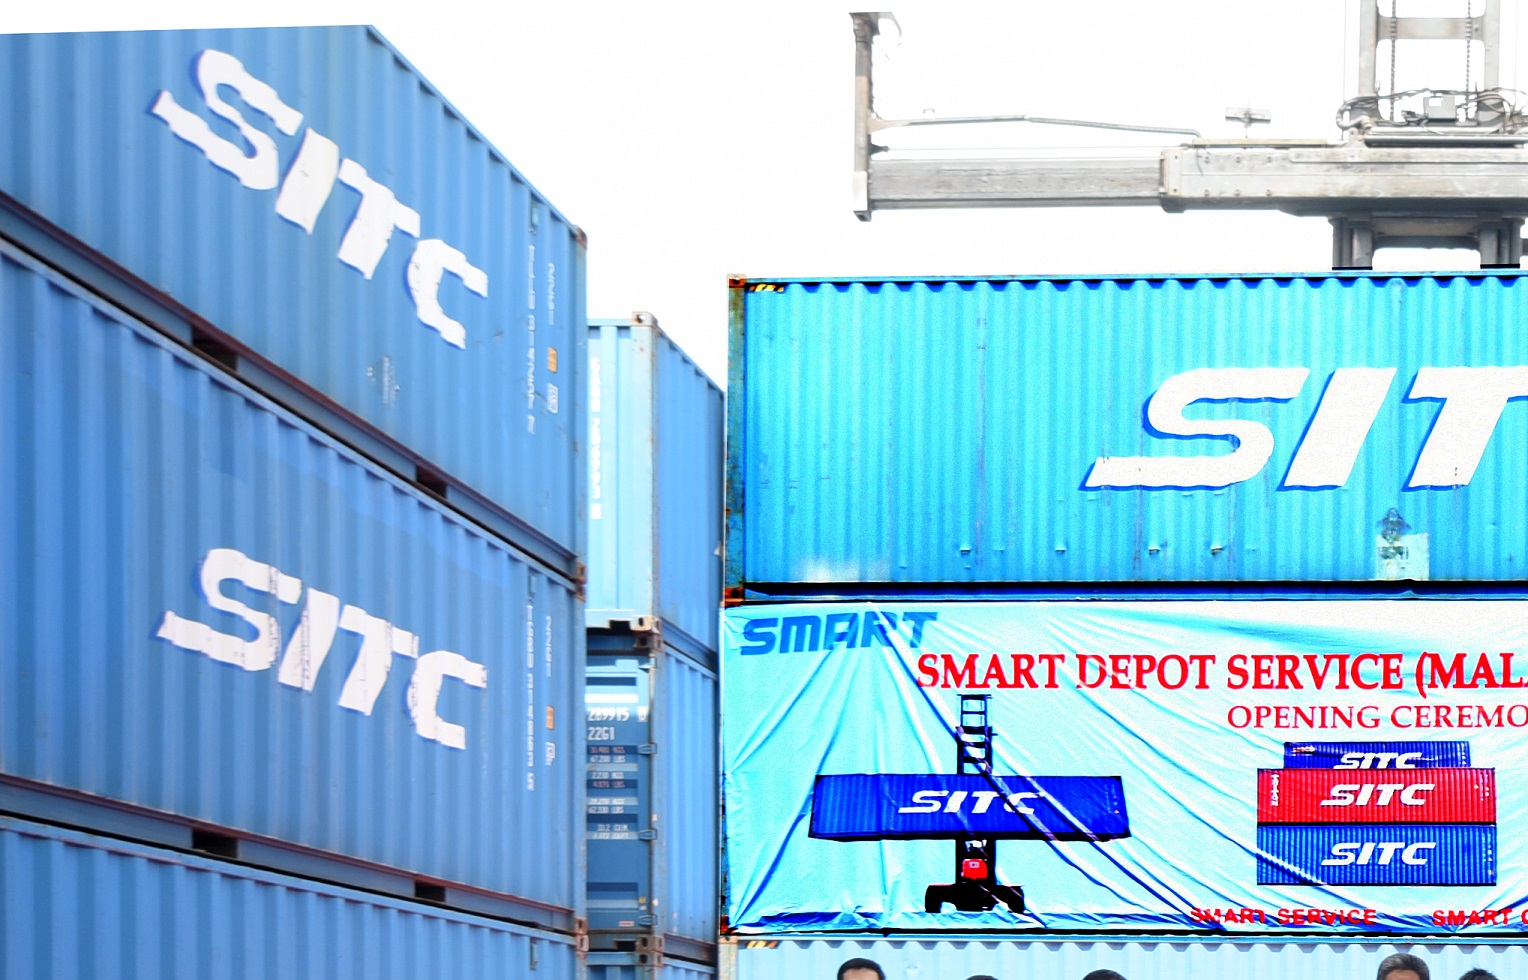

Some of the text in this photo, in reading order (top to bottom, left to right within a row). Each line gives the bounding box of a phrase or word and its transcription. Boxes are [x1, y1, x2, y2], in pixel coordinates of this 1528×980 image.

[150, 48, 488, 350] SITC
[740, 610, 938, 656] SMART
[155, 547, 488, 750] SITC
[916, 652, 1066, 690] SMART
[1076, 652, 1217, 691] DEPOT
[1227, 652, 1404, 690] SERVICE
[1227, 704, 1381, 730] OPENING
[1332, 752, 1423, 770] SITC
[898, 790, 1044, 815] SITC
[1319, 783, 1436, 806] SITC
[1320, 842, 1437, 866] SITC
[1276, 907, 1377, 926] SERVICE
[1432, 908, 1511, 927] SMART
